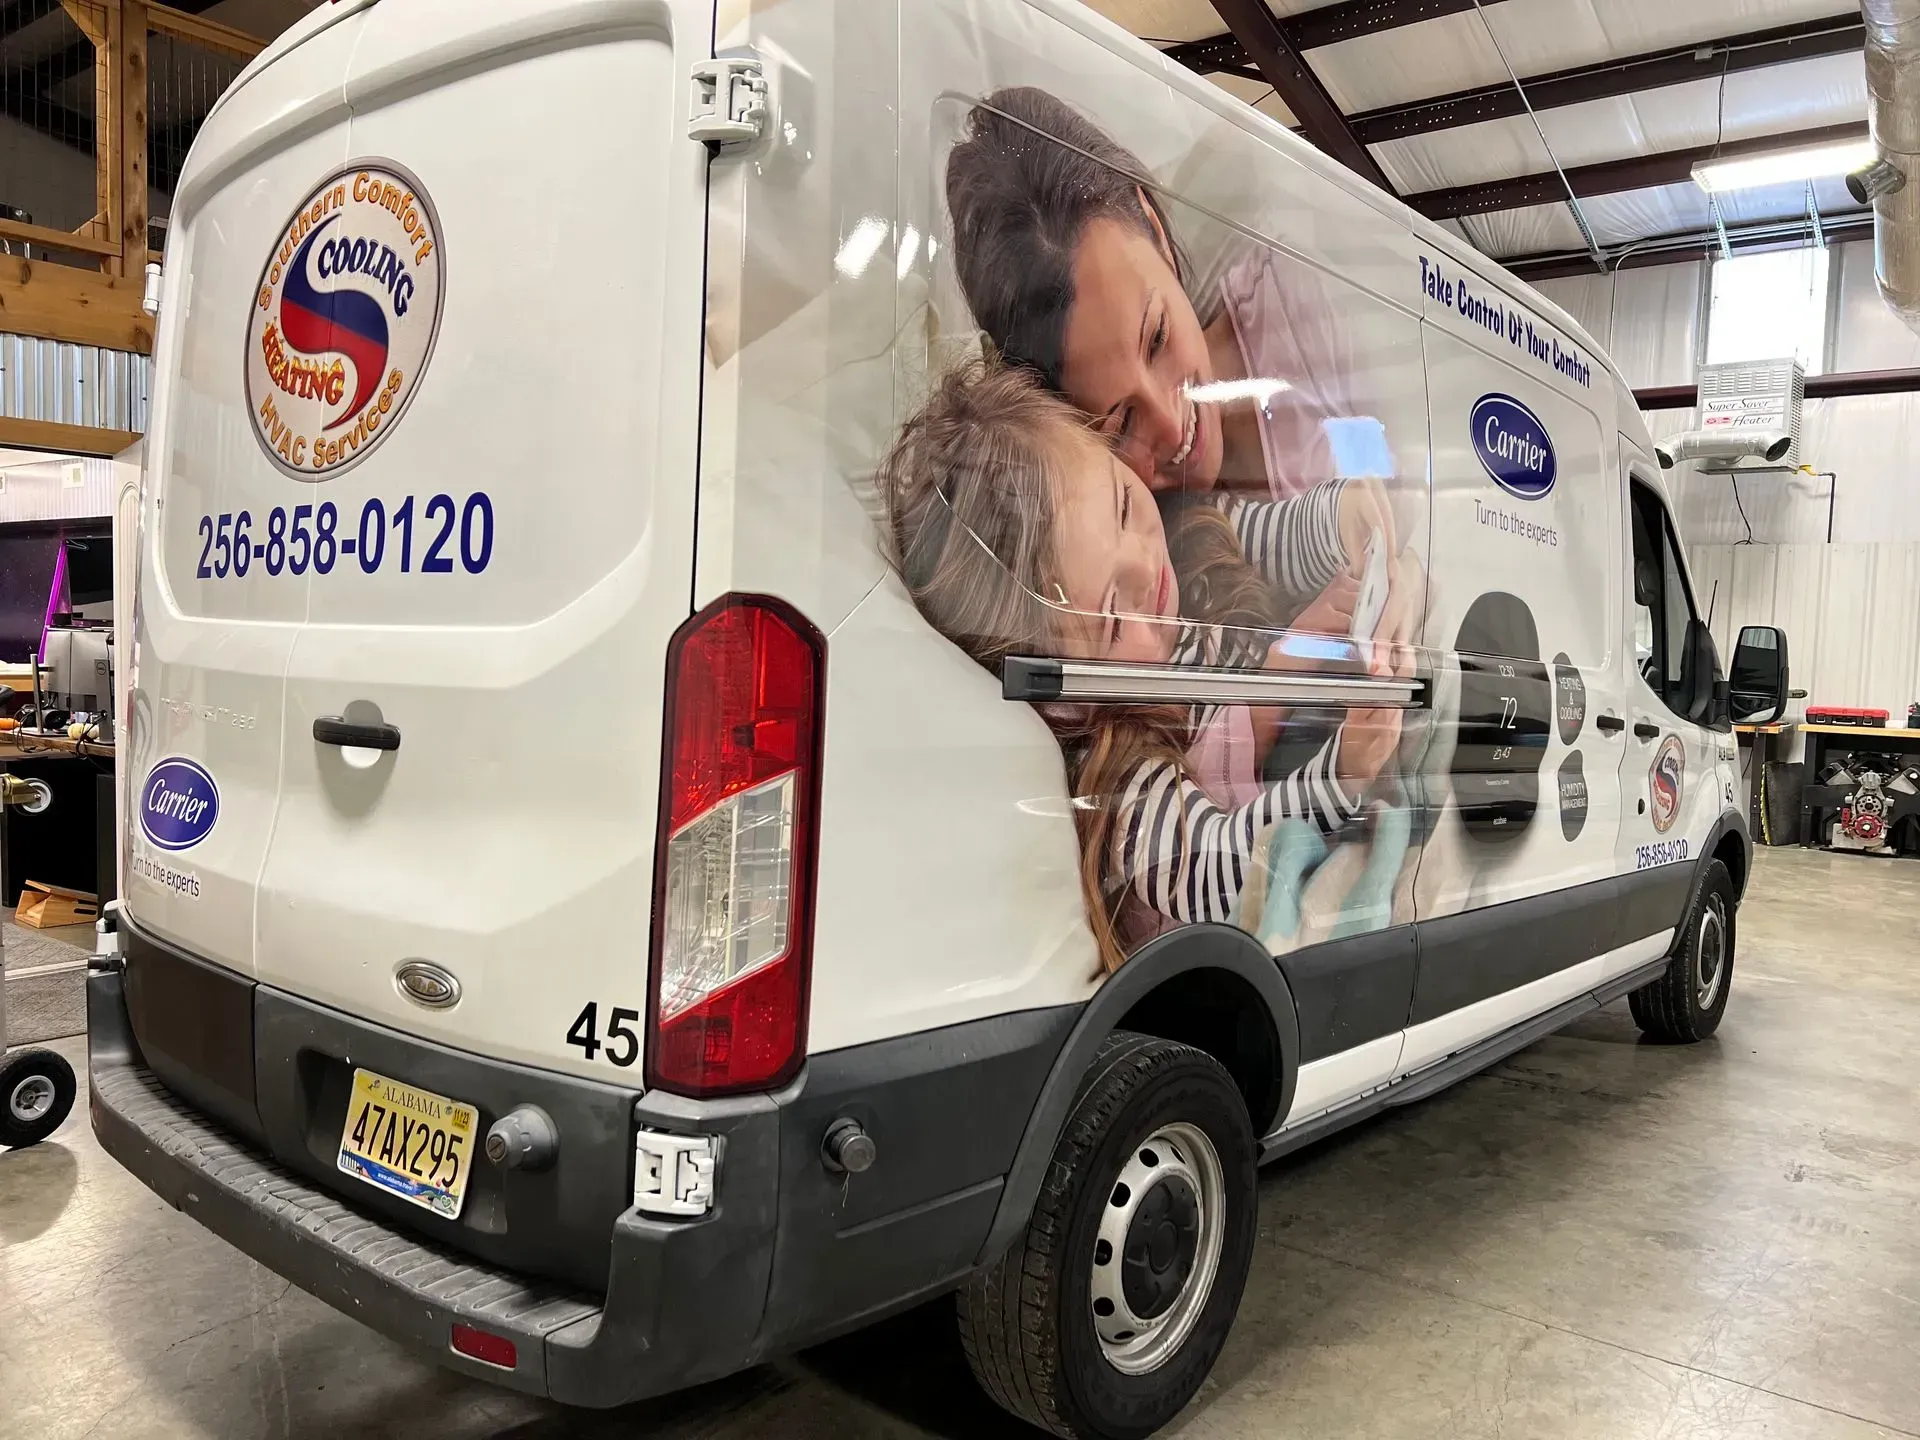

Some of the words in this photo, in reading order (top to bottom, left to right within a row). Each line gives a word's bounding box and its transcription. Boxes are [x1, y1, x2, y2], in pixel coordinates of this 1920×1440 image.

[258, 184, 346, 312] Southern
[352, 170, 434, 267] Comfort
[317, 236, 414, 318] COOLING
[1419, 255, 1452, 307] Take
[1457, 279, 1504, 338] Control
[1508, 310, 1523, 348] Of
[1525, 321, 1550, 364] Your
[1552, 338, 1591, 389] Comfort
[261, 322, 346, 406] HEATING
[259, 391, 307, 466] HVAC
[312, 366, 404, 468] Services
[1706, 400, 1738, 412] Super
[1740, 398, 1770, 410] Saver
[1732, 415, 1774, 426] Heater
[1485, 415, 1547, 473] Carrier
[196, 491, 494, 579] 256-858-0120
[1474, 498, 1497, 528] Turn
[1499, 509, 1509, 532] to
[1511, 512, 1525, 537] the
[1527, 521, 1558, 547] experts
[1500, 697, 1518, 729] 72
[148, 778, 208, 825] Carrier
[1725, 782, 1734, 804] 45
[145, 857, 152, 877] to
[153, 861, 165, 883] the
[167, 870, 200, 897] experts
[1635, 838, 1689, 869] 256-858-0120
[566, 1001, 639, 1067] 45
[382, 1086, 442, 1119] ALABAMA
[351, 1101, 464, 1188] 47AX295
